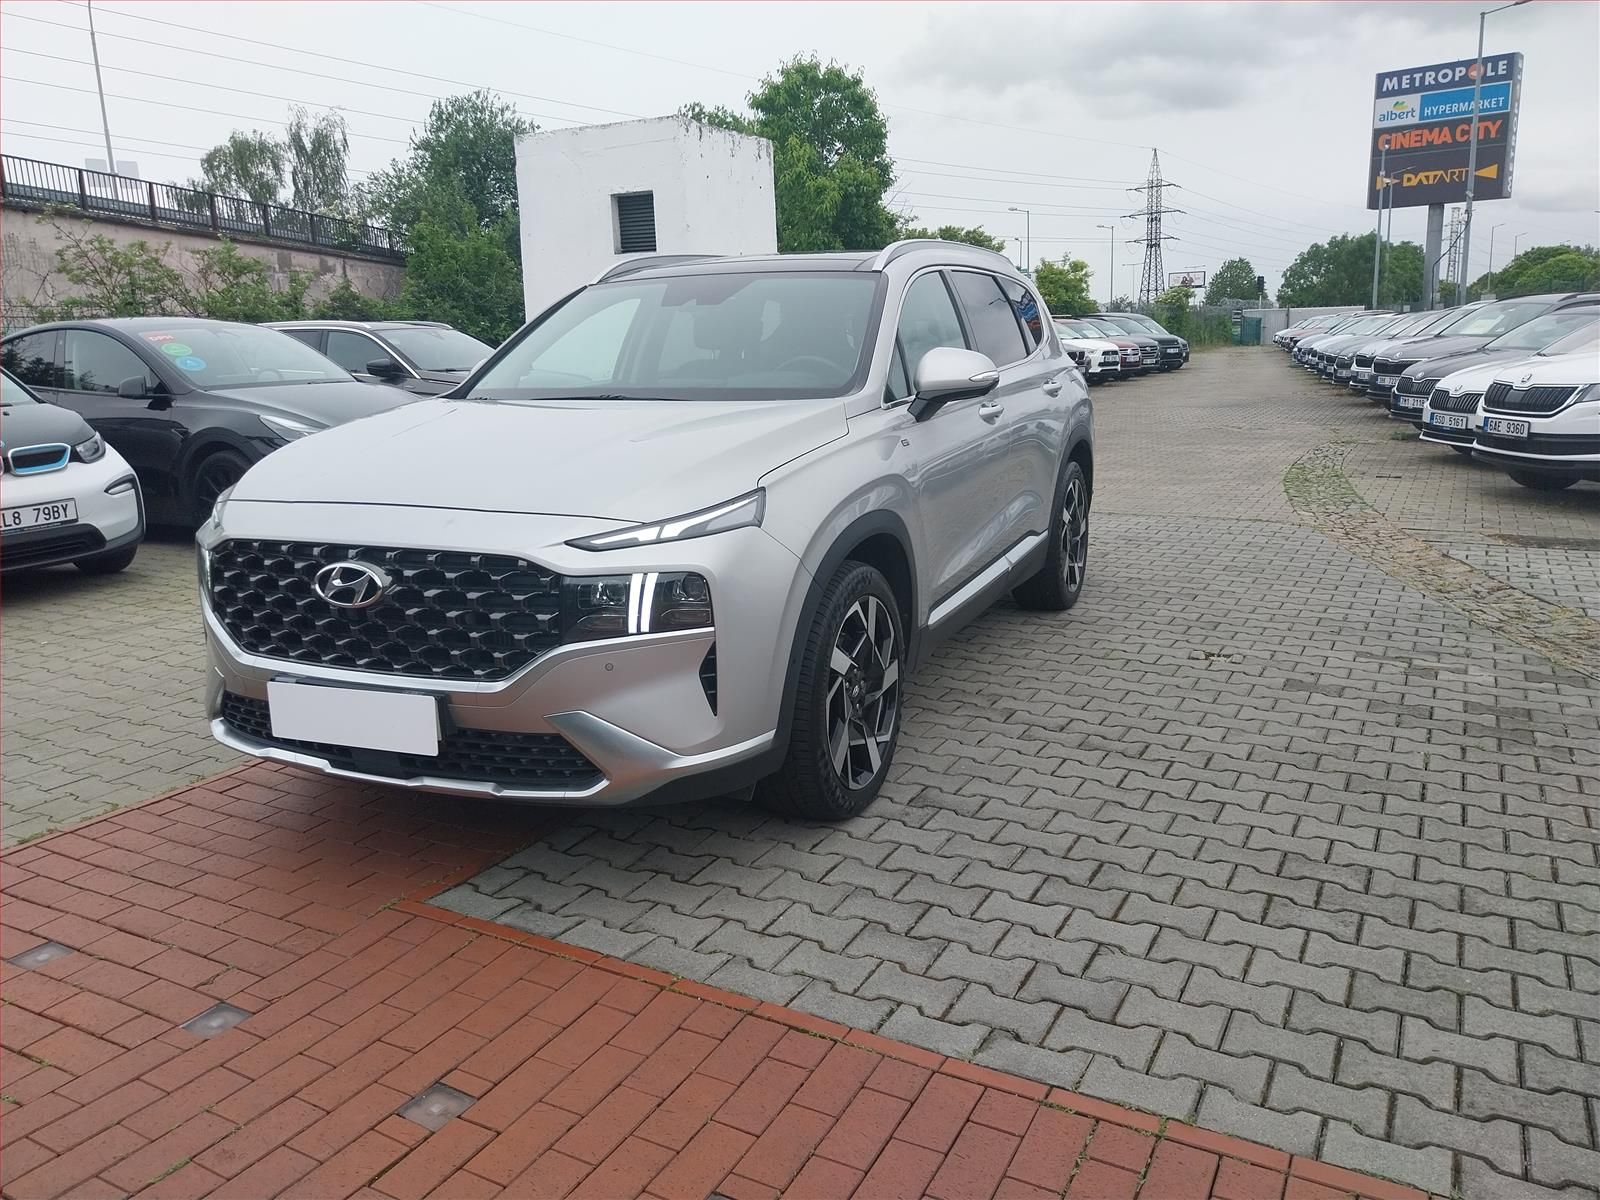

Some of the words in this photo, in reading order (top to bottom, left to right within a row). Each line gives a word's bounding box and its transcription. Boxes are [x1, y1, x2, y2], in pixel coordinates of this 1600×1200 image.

[1382, 60, 1507, 92] METROPOLE
[1379, 107, 1416, 122] albert
[1424, 97, 1505, 117] HYPERMARKET
[1378, 126, 1453, 151] CINEMA
[1403, 167, 1470, 187] DATART
[1488, 420, 1501, 432] 6AE
[1506, 422, 1525, 436] 9360
[0, 511, 22, 528] L8
[32, 503, 69, 523] 79BY
